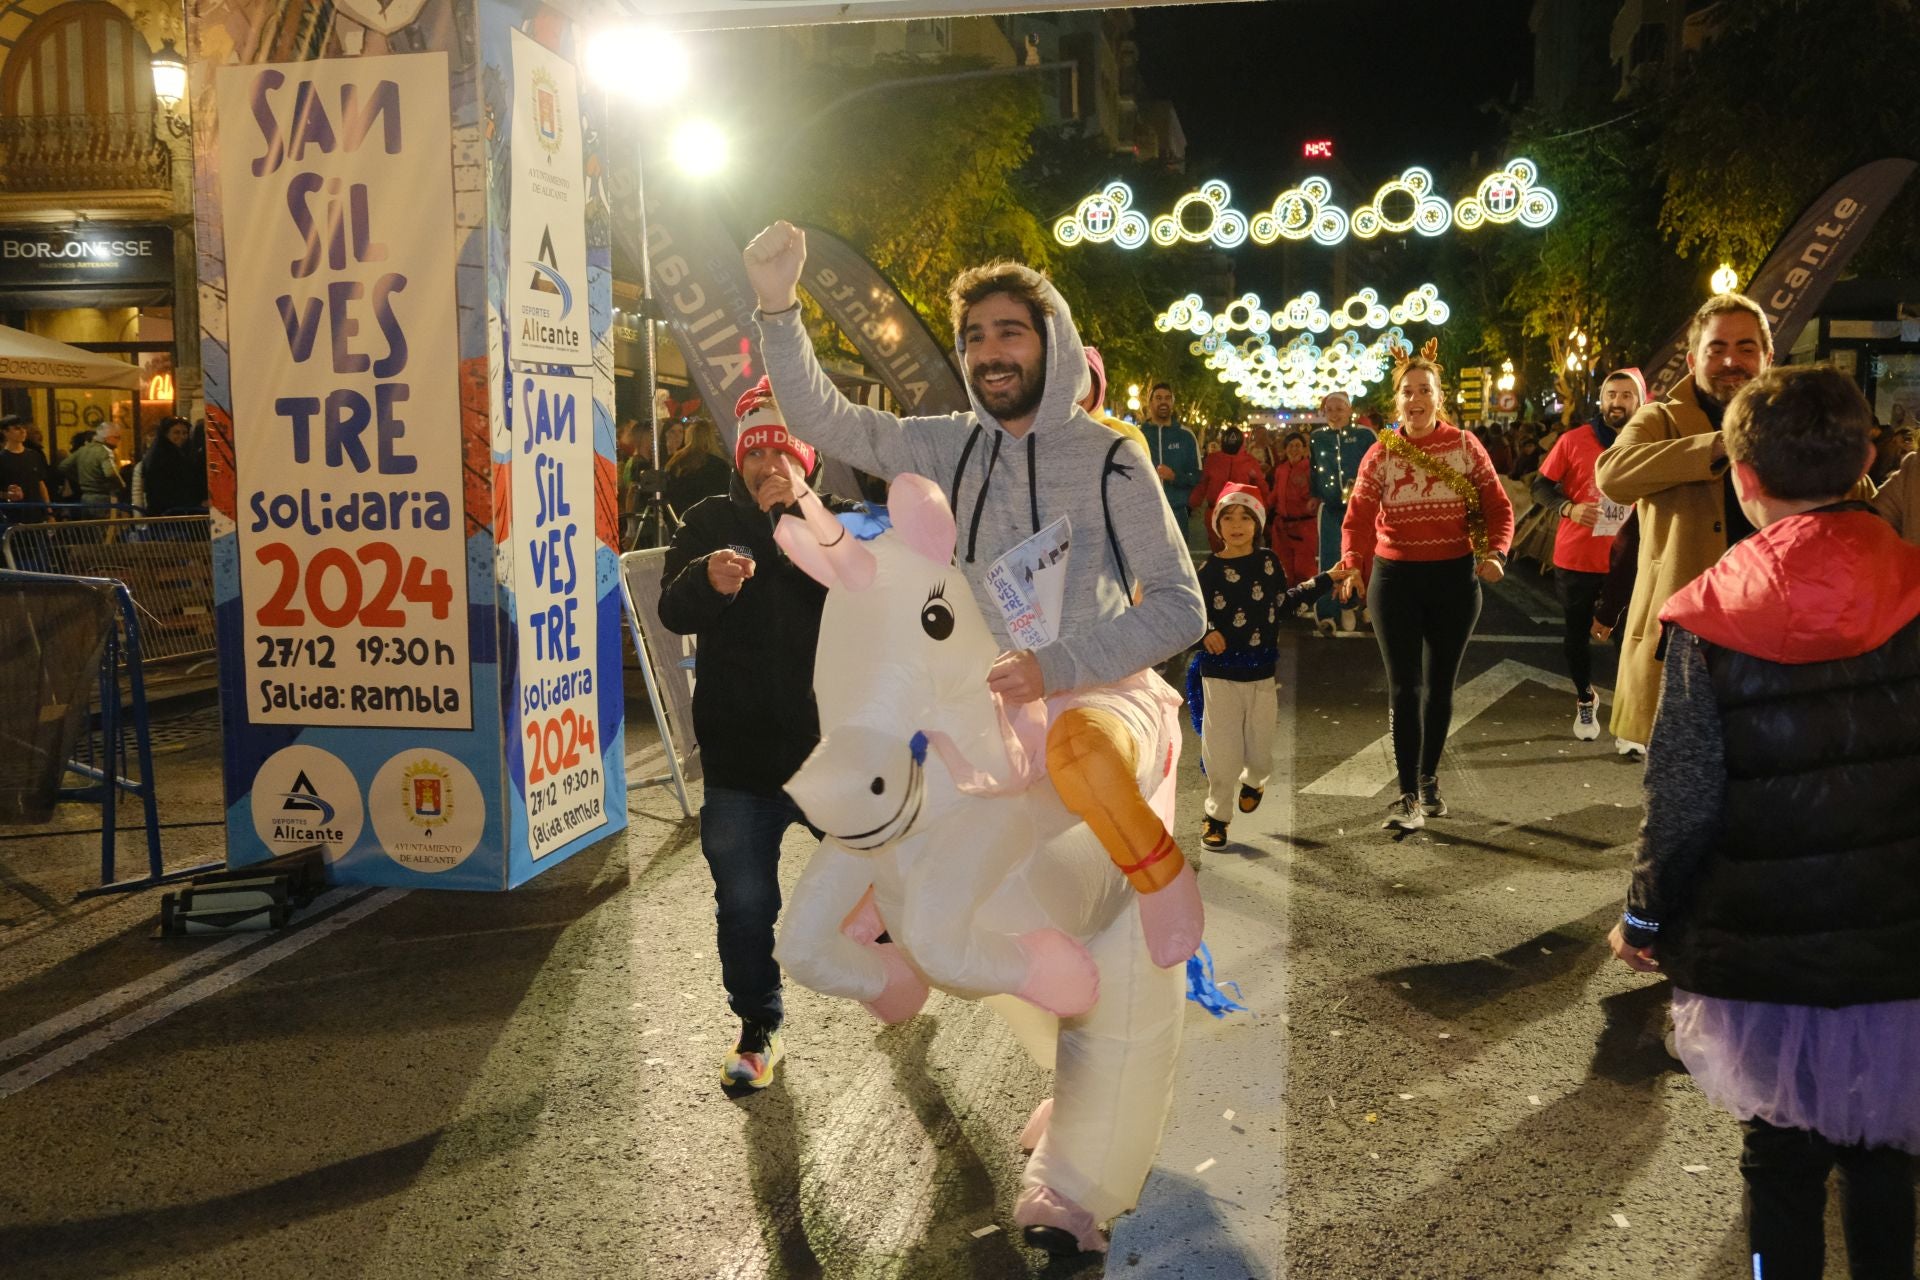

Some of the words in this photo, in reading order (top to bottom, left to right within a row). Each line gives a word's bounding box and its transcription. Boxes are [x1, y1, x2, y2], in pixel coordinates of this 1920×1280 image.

[251, 69, 402, 178] SAN
[528, 167, 570, 190] AYUNTAMIENTO
[532, 182, 542, 194] DE
[541, 186, 568, 202] ALICANTE
[521, 304, 551, 319] DEPORTES
[275, 272, 409, 379] VES
[521, 318, 580, 347] Alicante
[0, 357, 89, 379] BORGONESSE
[523, 377, 576, 455] SAN
[275, 383, 419, 475] TRE
[743, 430, 768, 448] OH
[1605, 505, 1625, 521] 448
[529, 522, 578, 596] VES
[255, 541, 453, 628] 2024
[986, 565, 1004, 585] SAN
[997, 584, 1017, 602] VES
[1003, 595, 1024, 613] TRE
[529, 597, 580, 663] TRE
[1009, 613, 1036, 633] 2024
[256, 635, 336, 668] 27/12
[351, 684, 460, 714] Rambla
[526, 708, 595, 785] 2024
[530, 782, 557, 816] 27/12
[272, 818, 307, 826] DEPORTES
[564, 797, 600, 831] Rambla
[274, 825, 344, 841] Alicante
[394, 842, 463, 855] AYUNTAMIENTO
[400, 854, 413, 865] DE
[414, 854, 458, 865] ALICANTE
